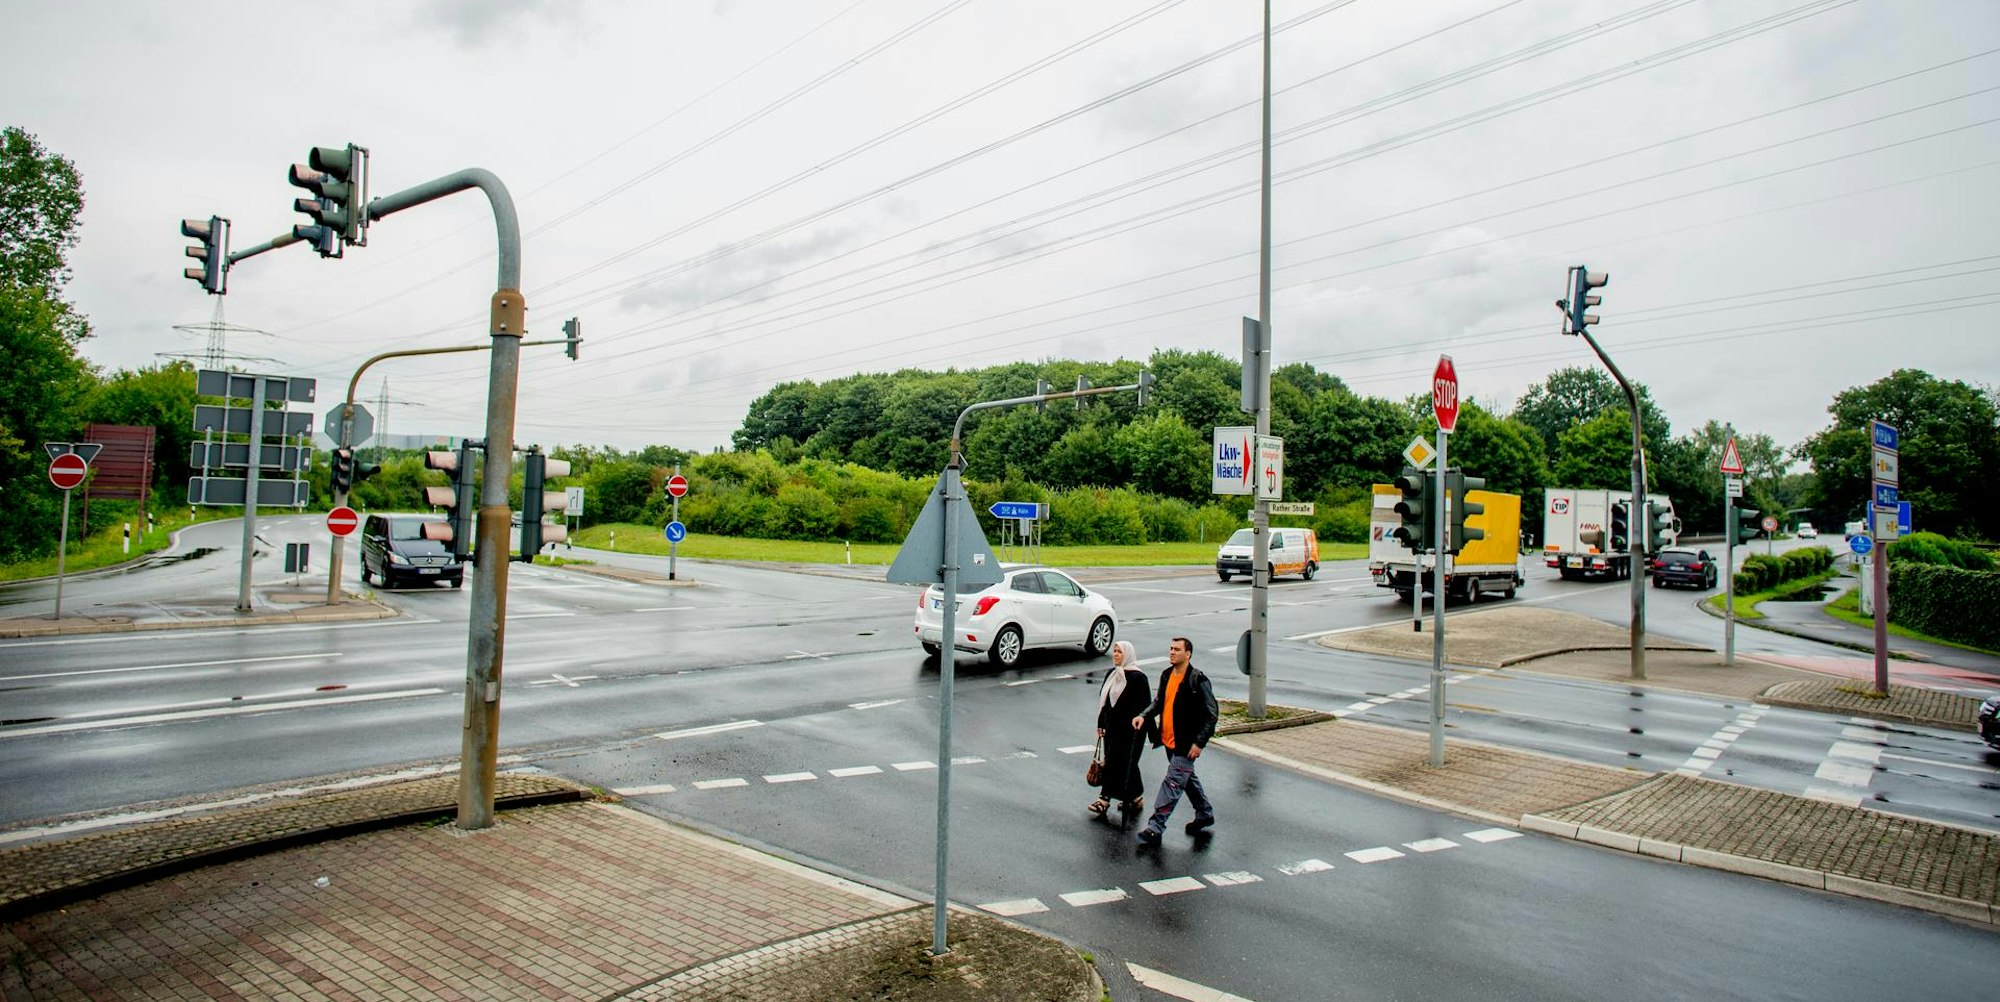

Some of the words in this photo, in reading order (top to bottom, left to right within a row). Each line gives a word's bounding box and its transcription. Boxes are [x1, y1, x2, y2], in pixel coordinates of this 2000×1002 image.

[1434, 377, 1457, 410] STOP
[1219, 443, 1241, 460] Lkw-
[1216, 463, 1242, 479] Wäsche
[1272, 503, 1291, 512] Rather
[1292, 504, 1311, 513] Straße
[1554, 503, 1567, 511] TIP
